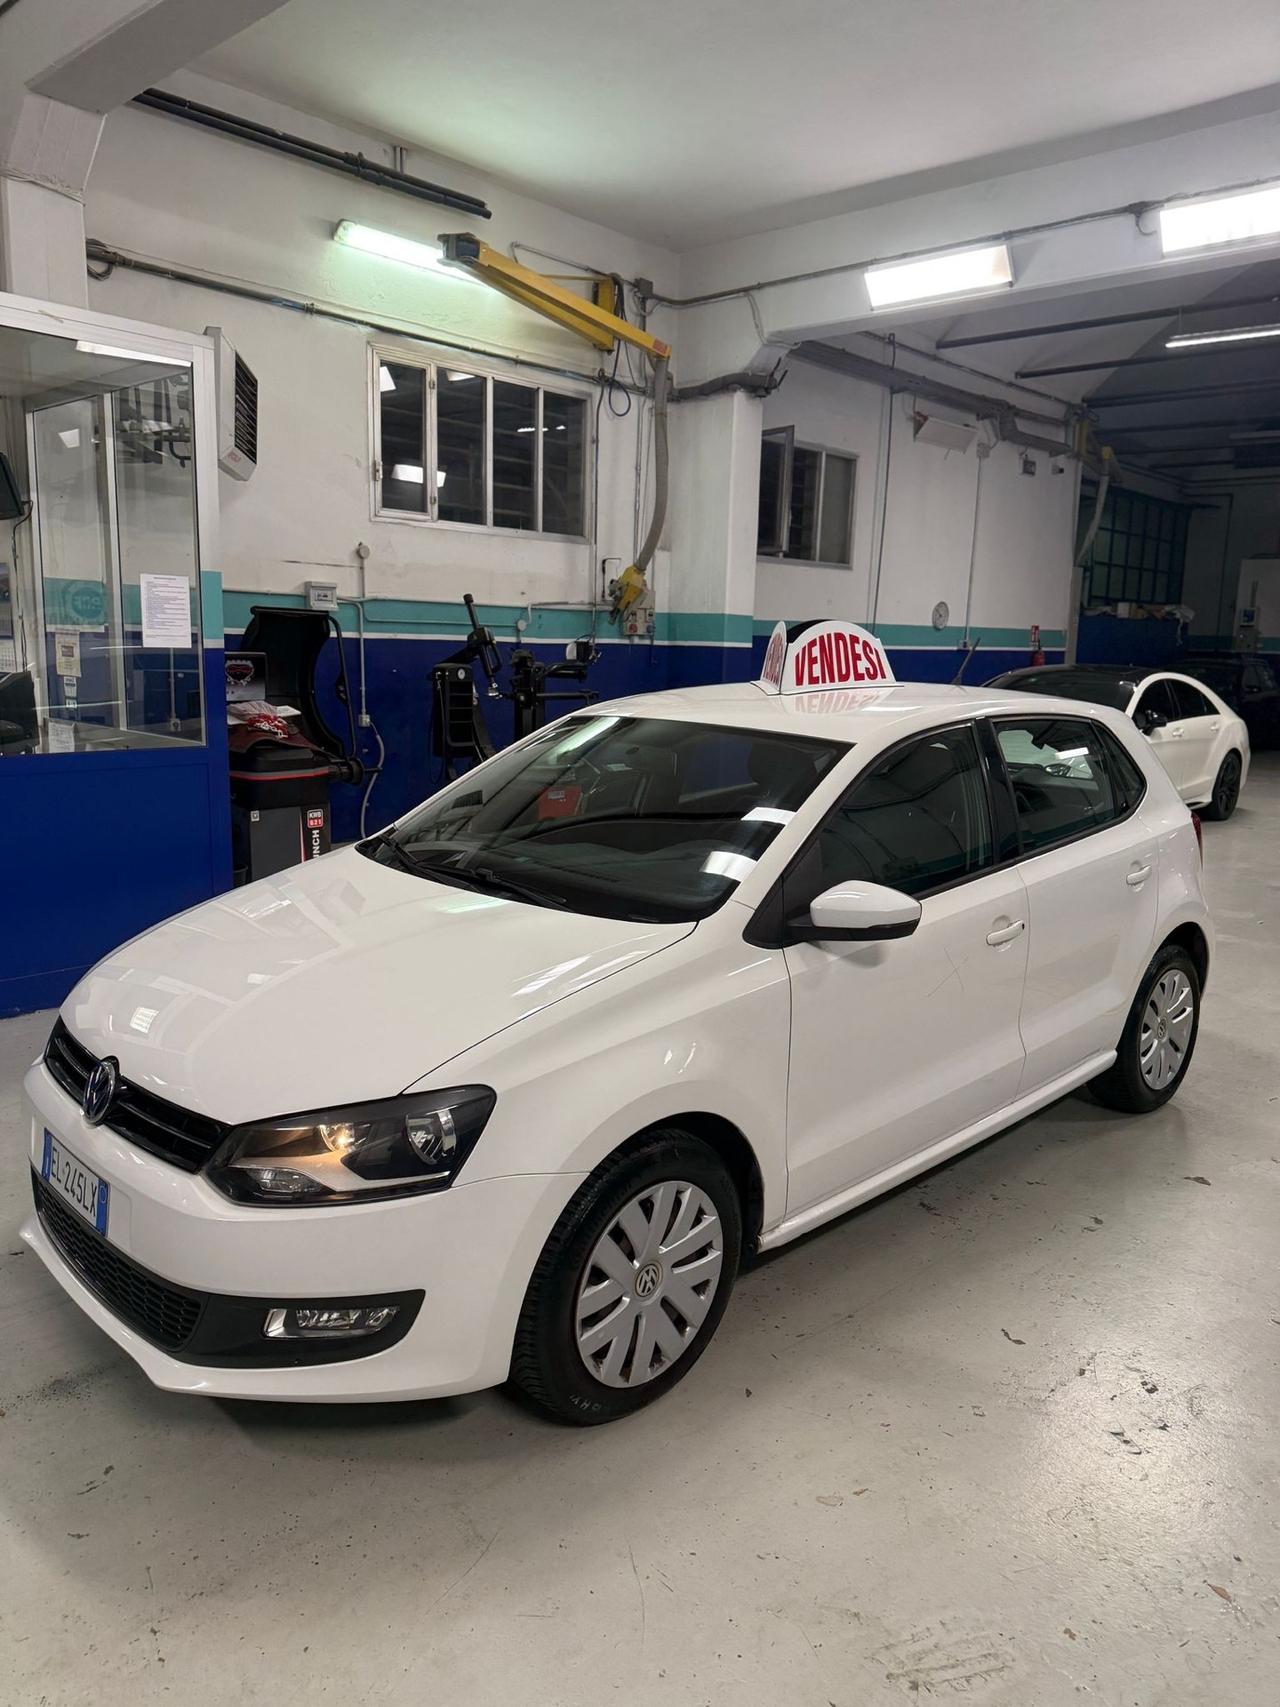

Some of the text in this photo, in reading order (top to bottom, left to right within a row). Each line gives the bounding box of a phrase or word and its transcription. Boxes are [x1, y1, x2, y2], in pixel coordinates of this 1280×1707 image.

[795, 632, 887, 686] VENDESI
[51, 1146, 97, 1217] EL 245LX
